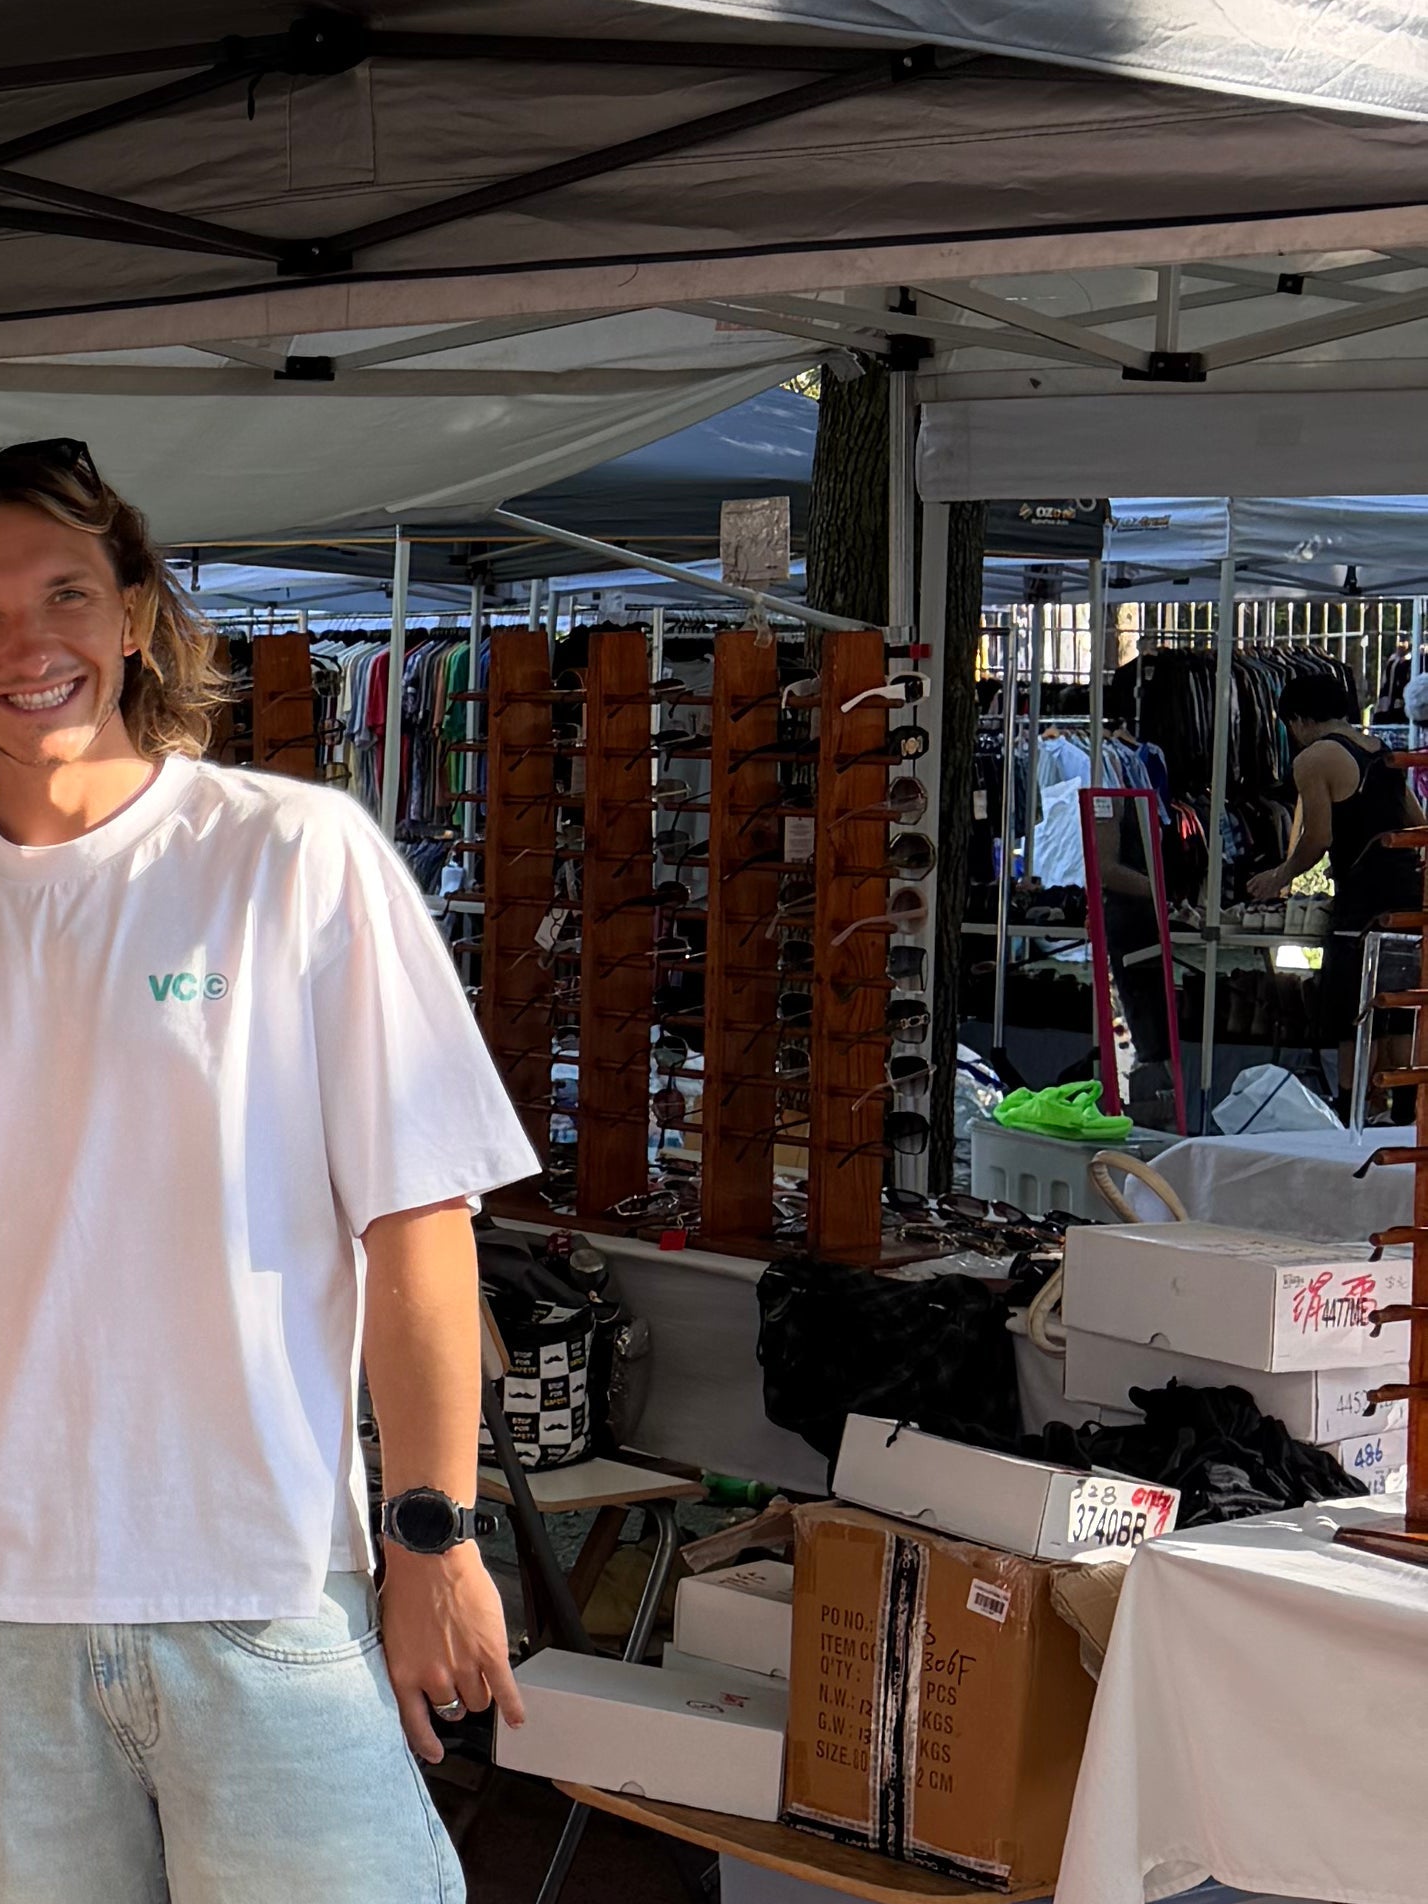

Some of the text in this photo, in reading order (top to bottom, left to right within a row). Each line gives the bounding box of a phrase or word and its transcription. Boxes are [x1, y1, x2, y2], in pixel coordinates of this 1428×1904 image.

[1354, 1438, 1384, 1468] 486
[1073, 1479, 1117, 1506] 328
[821, 1604, 840, 1626] PO
[821, 1632, 856, 1658] ITEM
[926, 1680, 957, 1706] PCS
[922, 1709, 954, 1735] KGS
[919, 1738, 952, 1764] KGS
[929, 1771, 954, 1794] CM
